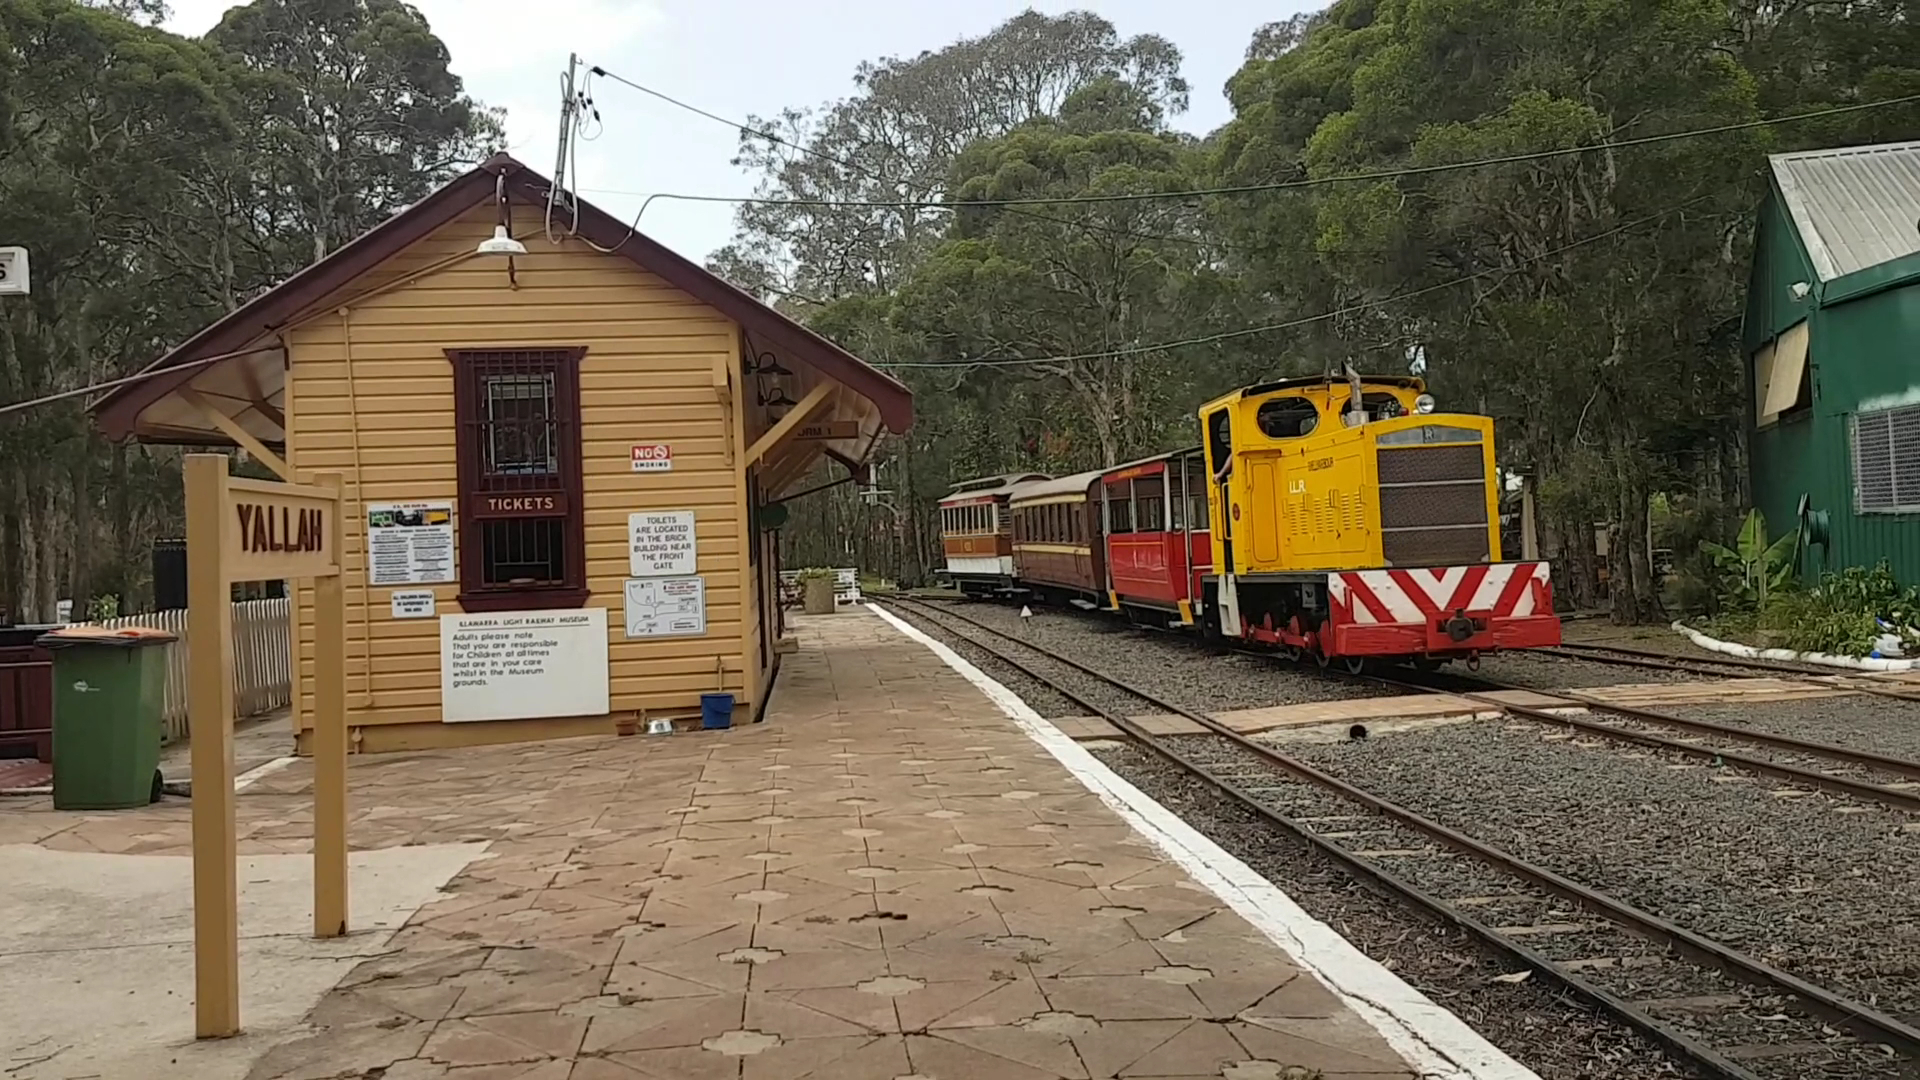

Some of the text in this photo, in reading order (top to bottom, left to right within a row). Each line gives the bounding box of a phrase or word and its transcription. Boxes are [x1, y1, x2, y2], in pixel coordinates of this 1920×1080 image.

[634, 447, 653, 459] NO
[488, 497, 554, 511] TICKETS
[646, 516, 677, 525] TOILETS
[236, 503, 322, 553] YALLAH
[635, 525, 689, 535] ARE LOCATED
[636, 534, 688, 543] IN THE BRICK
[633, 542, 692, 553] BUILDING NEAR
[641, 552, 684, 561] THE FRONT
[653, 561, 674, 570] GATE
[503, 618, 523, 626] LIGHT
[559, 616, 589, 624] MUSEUM
[481, 633, 510, 641] please
[473, 643, 489, 651] you
[510, 640, 558, 649] responsible
[466, 651, 502, 659] Children
[502, 660, 520, 668] your
[508, 668, 544, 676] Museum
